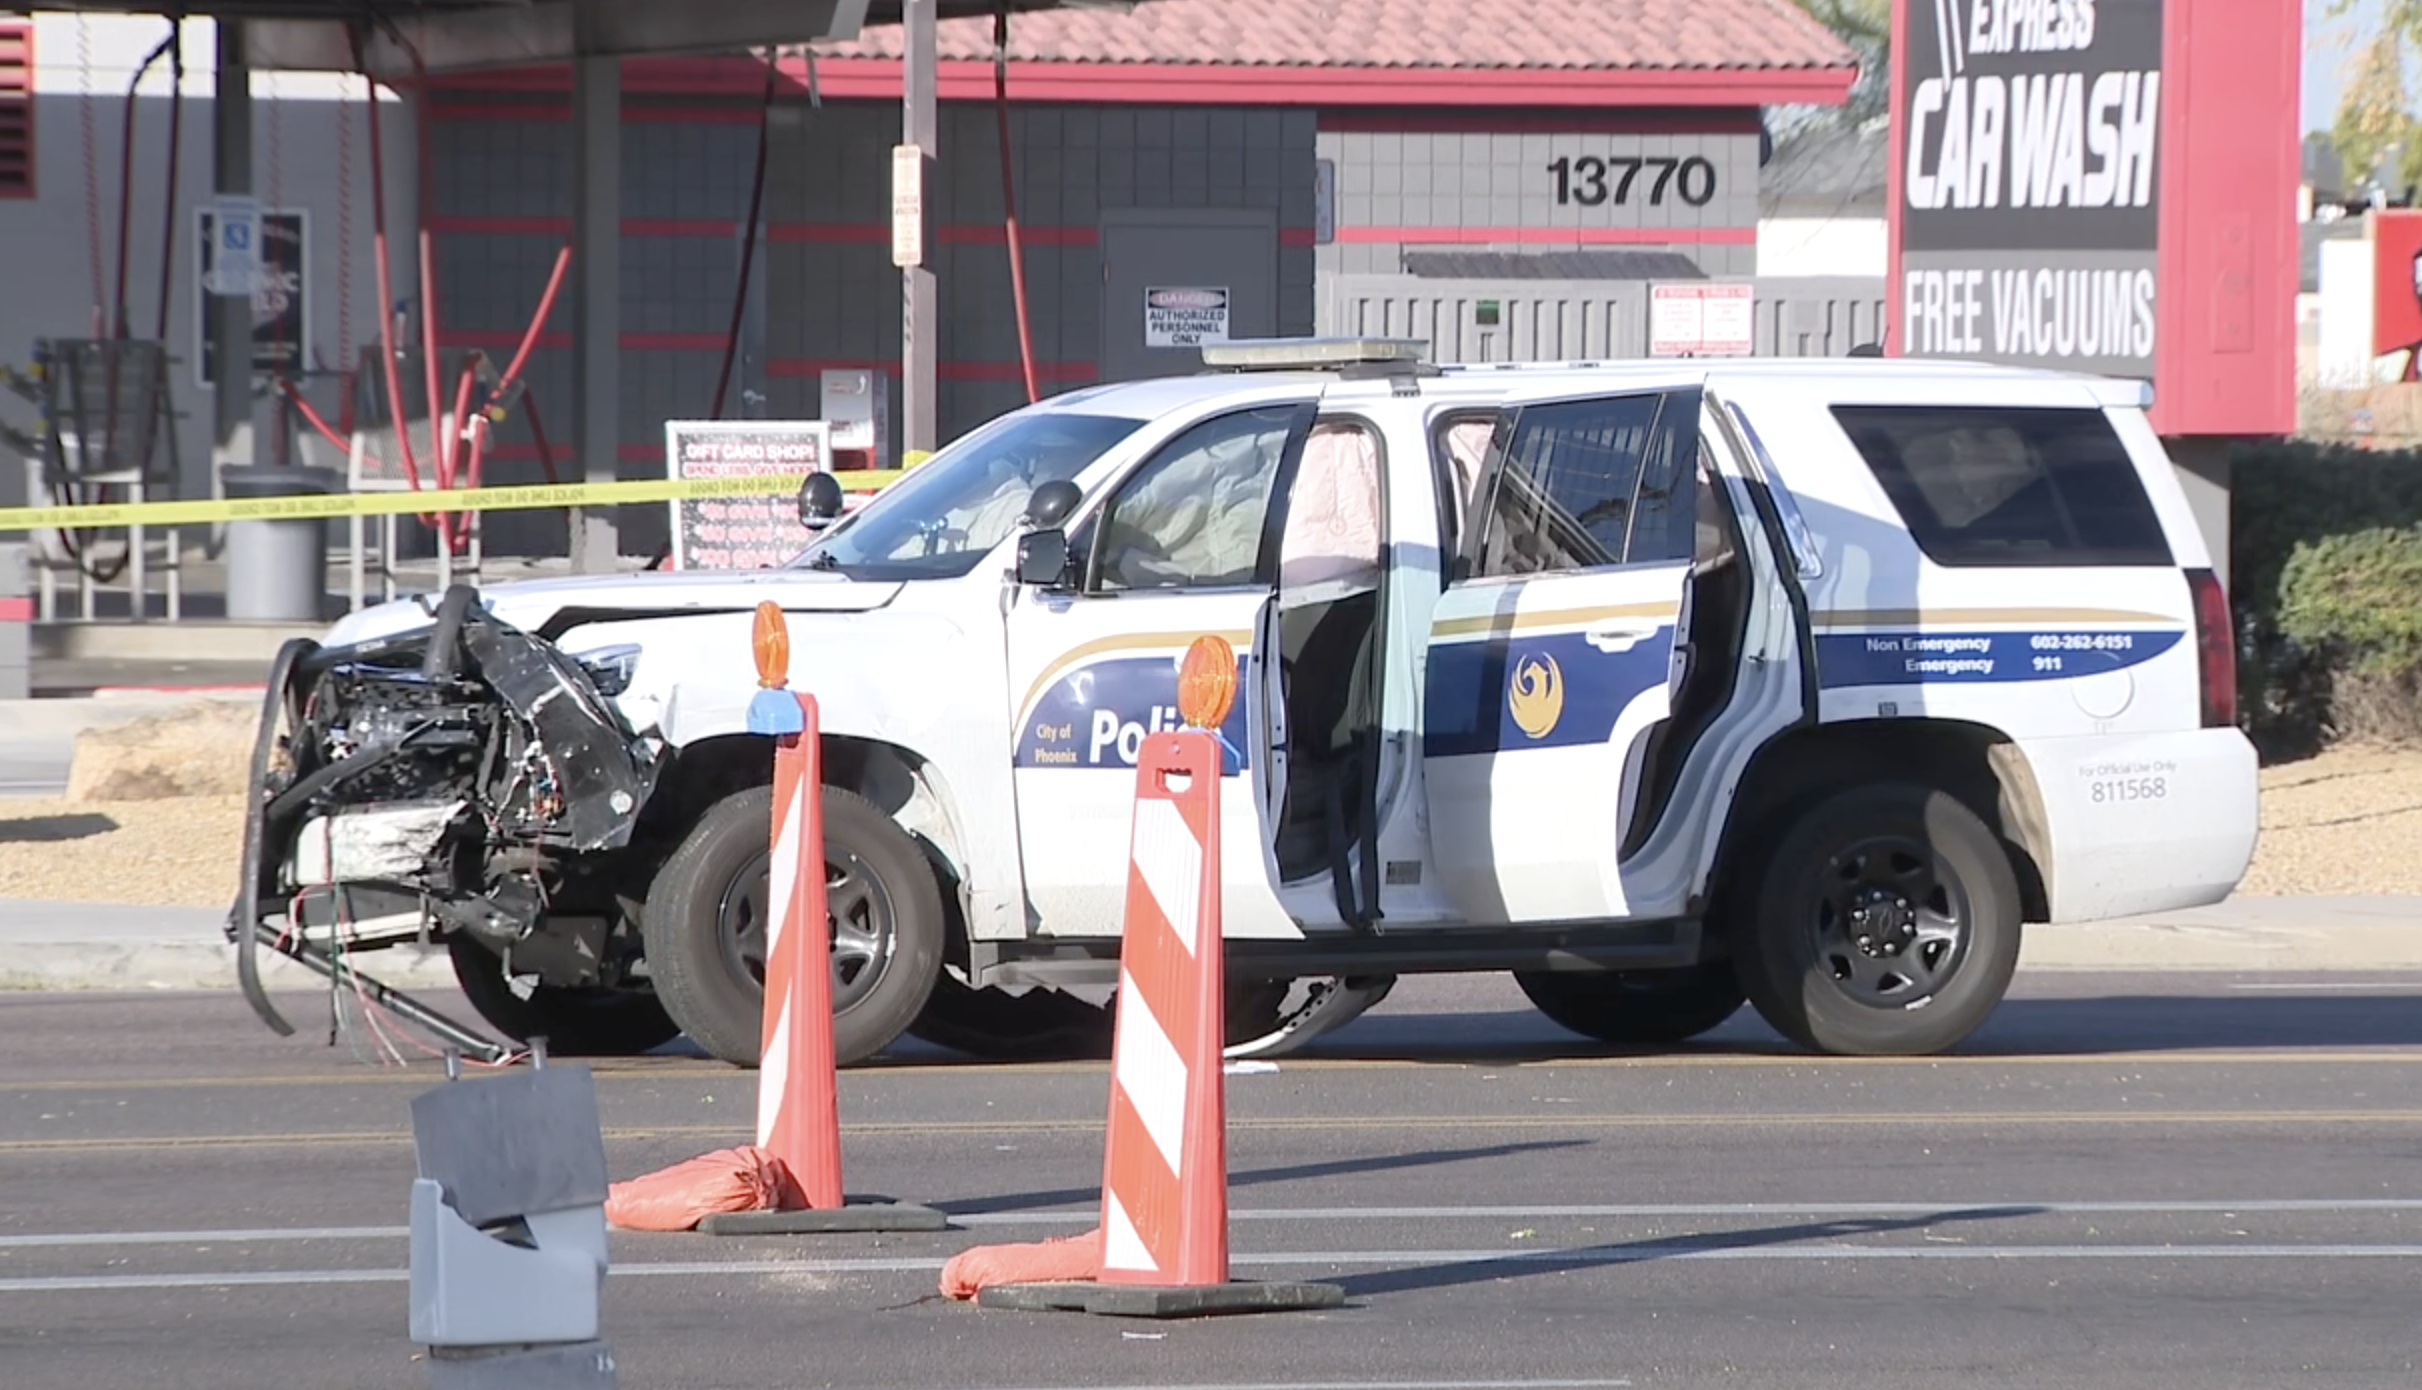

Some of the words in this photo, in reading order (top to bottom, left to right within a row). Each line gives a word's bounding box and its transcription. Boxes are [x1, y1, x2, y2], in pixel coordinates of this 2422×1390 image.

[1968, 0, 2096, 54] EXPRESS
[1906, 76, 2007, 209] CAR
[2010, 70, 2161, 208] WASH
[1547, 155, 1716, 207] 13770
[1149, 310, 1225, 321] AUTHORIZED
[1904, 269, 1984, 355] FREE
[1991, 268, 2155, 358] VACUUMS
[1152, 322, 1221, 333] PERSONNEL
[1171, 333, 1201, 344] ONLY
[686, 444, 719, 460] GIFT
[722, 444, 765, 460] CARD
[766, 443, 815, 460] SHOP!
[1866, 638, 1900, 651] Non
[1903, 637, 1991, 654] Emergency
[2030, 634, 2133, 650] 602-262-6151
[1905, 658, 1994, 675] Emergency
[2032, 655, 2062, 671] 911
[1036, 723, 1057, 743] City
[1059, 723, 1072, 740] of
[1035, 748, 1078, 764] Phoenix
[2079, 766, 2094, 777] For
[2097, 763, 2130, 776] Official
[2132, 762, 2151, 774] Use
[2153, 760, 2177, 774] Only
[2091, 777, 2167, 803] 811568
